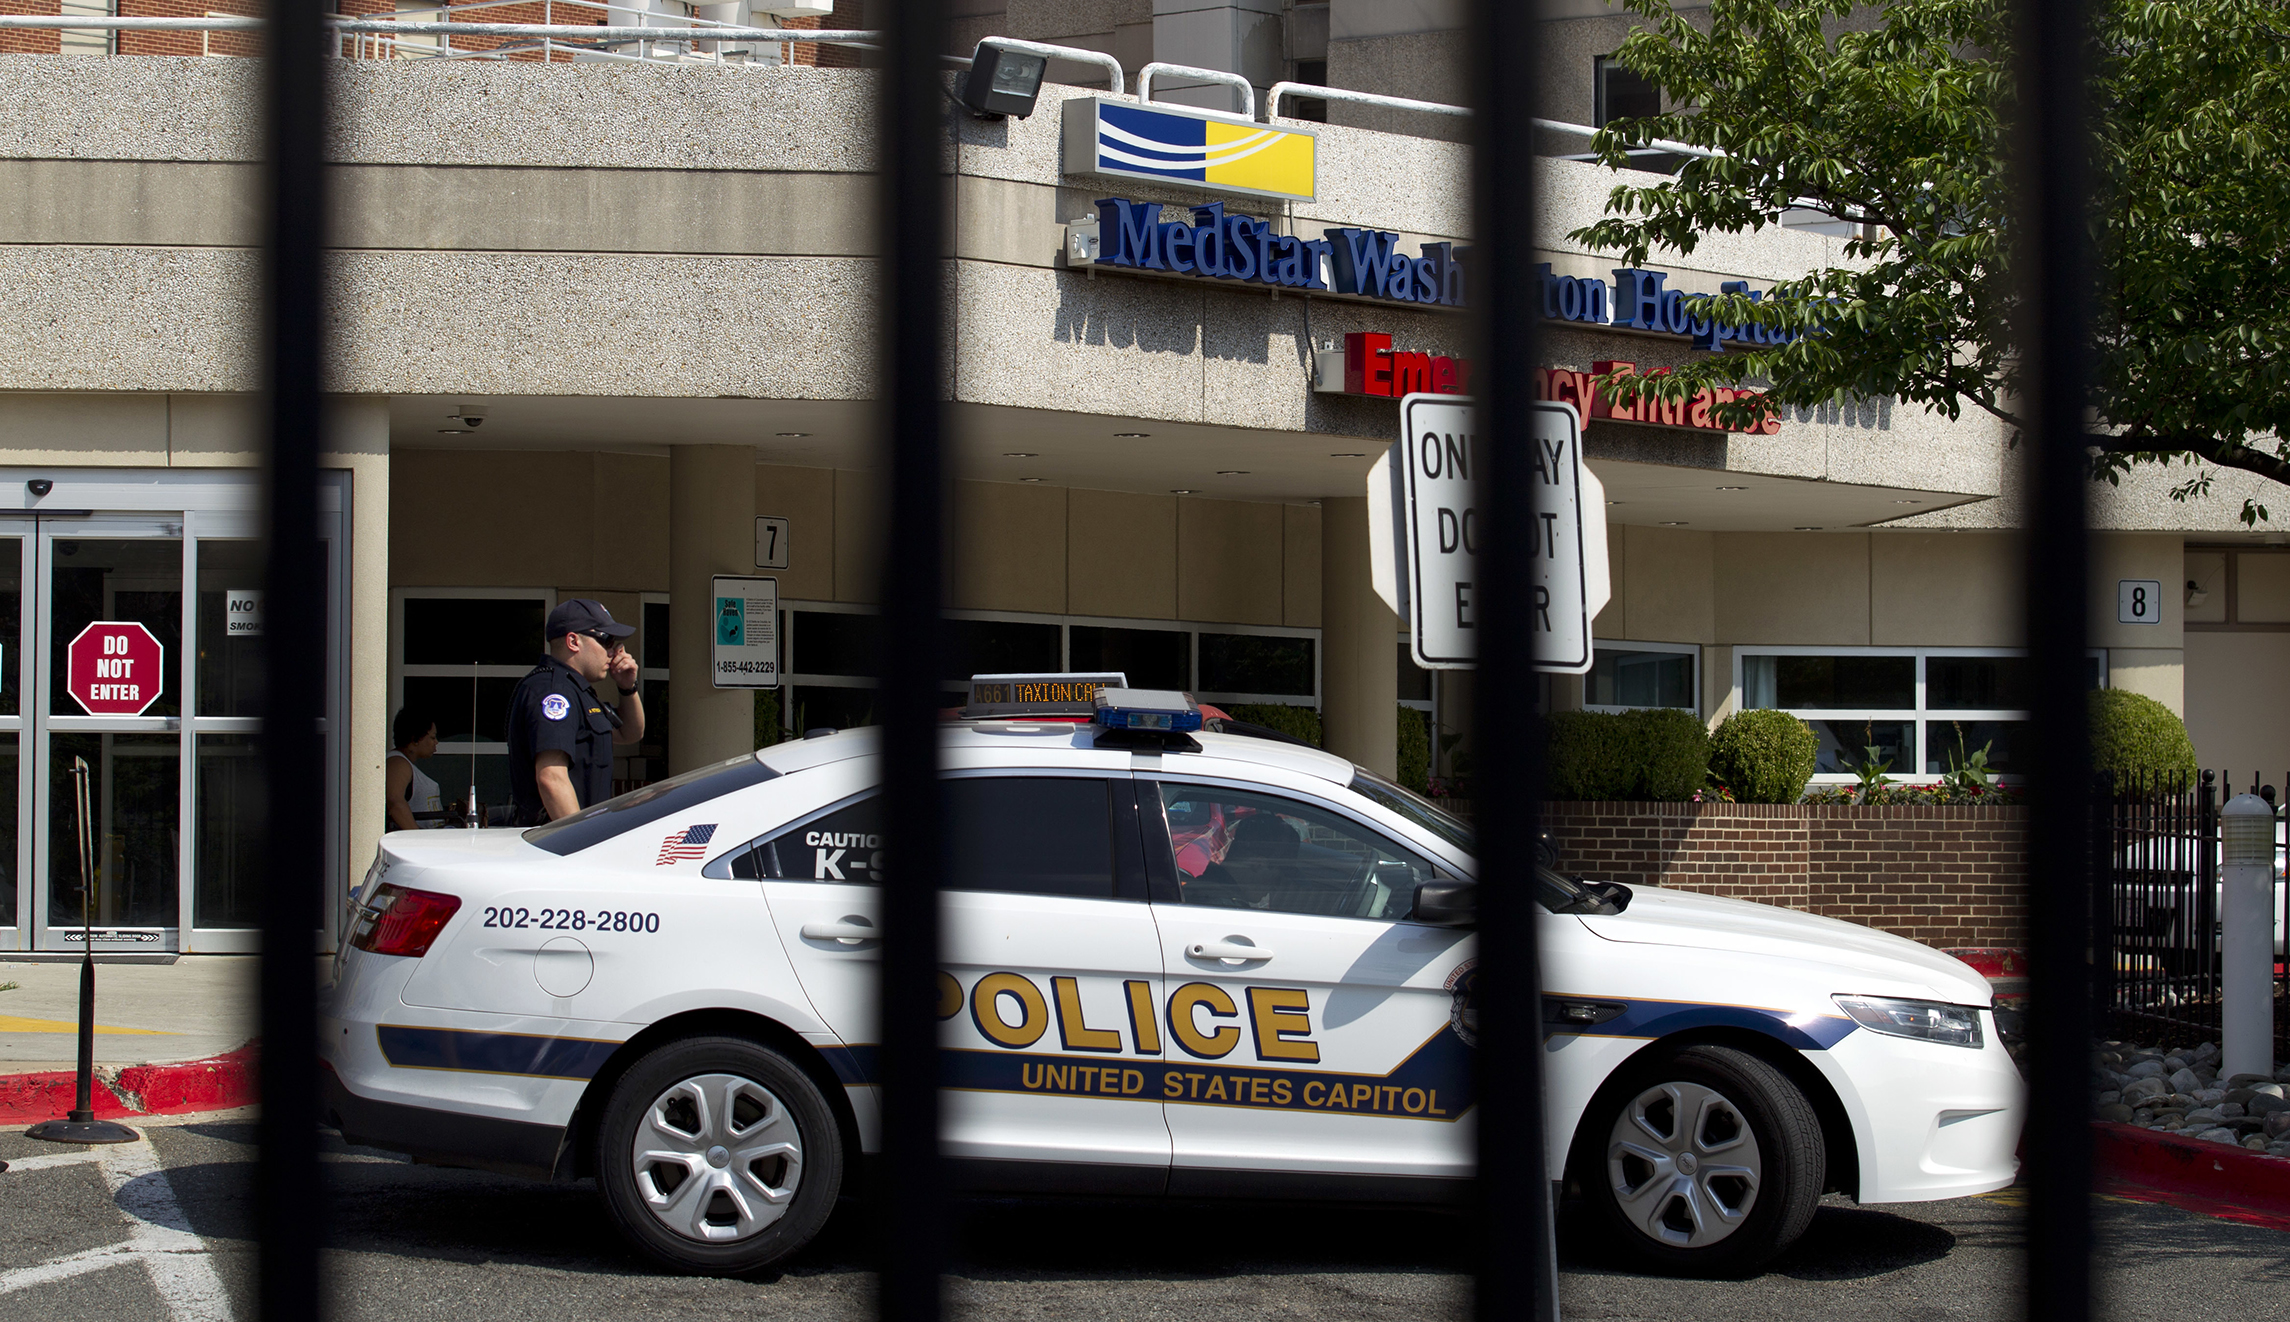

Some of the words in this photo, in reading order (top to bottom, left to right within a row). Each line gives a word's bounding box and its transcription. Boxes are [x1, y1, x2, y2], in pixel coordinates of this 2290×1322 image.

[1095, 197, 1334, 291] MedStar
[1324, 228, 1608, 325] Washton
[1345, 331, 1599, 432] Emency
[1421, 431, 1478, 481] ON
[766, 525, 778, 560] 7
[230, 600, 255, 612] NO
[2131, 587, 2147, 617] 8
[103, 635, 129, 656] DO
[96, 658, 135, 679] NOT
[716, 660, 775, 674] 1-855-442-2229
[90, 684, 140, 701] ENTER
[975, 684, 1010, 703] A661
[806, 831, 884, 849] CAUTIO
[483, 907, 660, 934] 202-228-2800
[1445, 967, 1465, 989] UNITED
[1022, 1063, 1145, 1095] UNITED
[1163, 1071, 1293, 1106] STATES
[1303, 1081, 1447, 1115] CAPITOL
